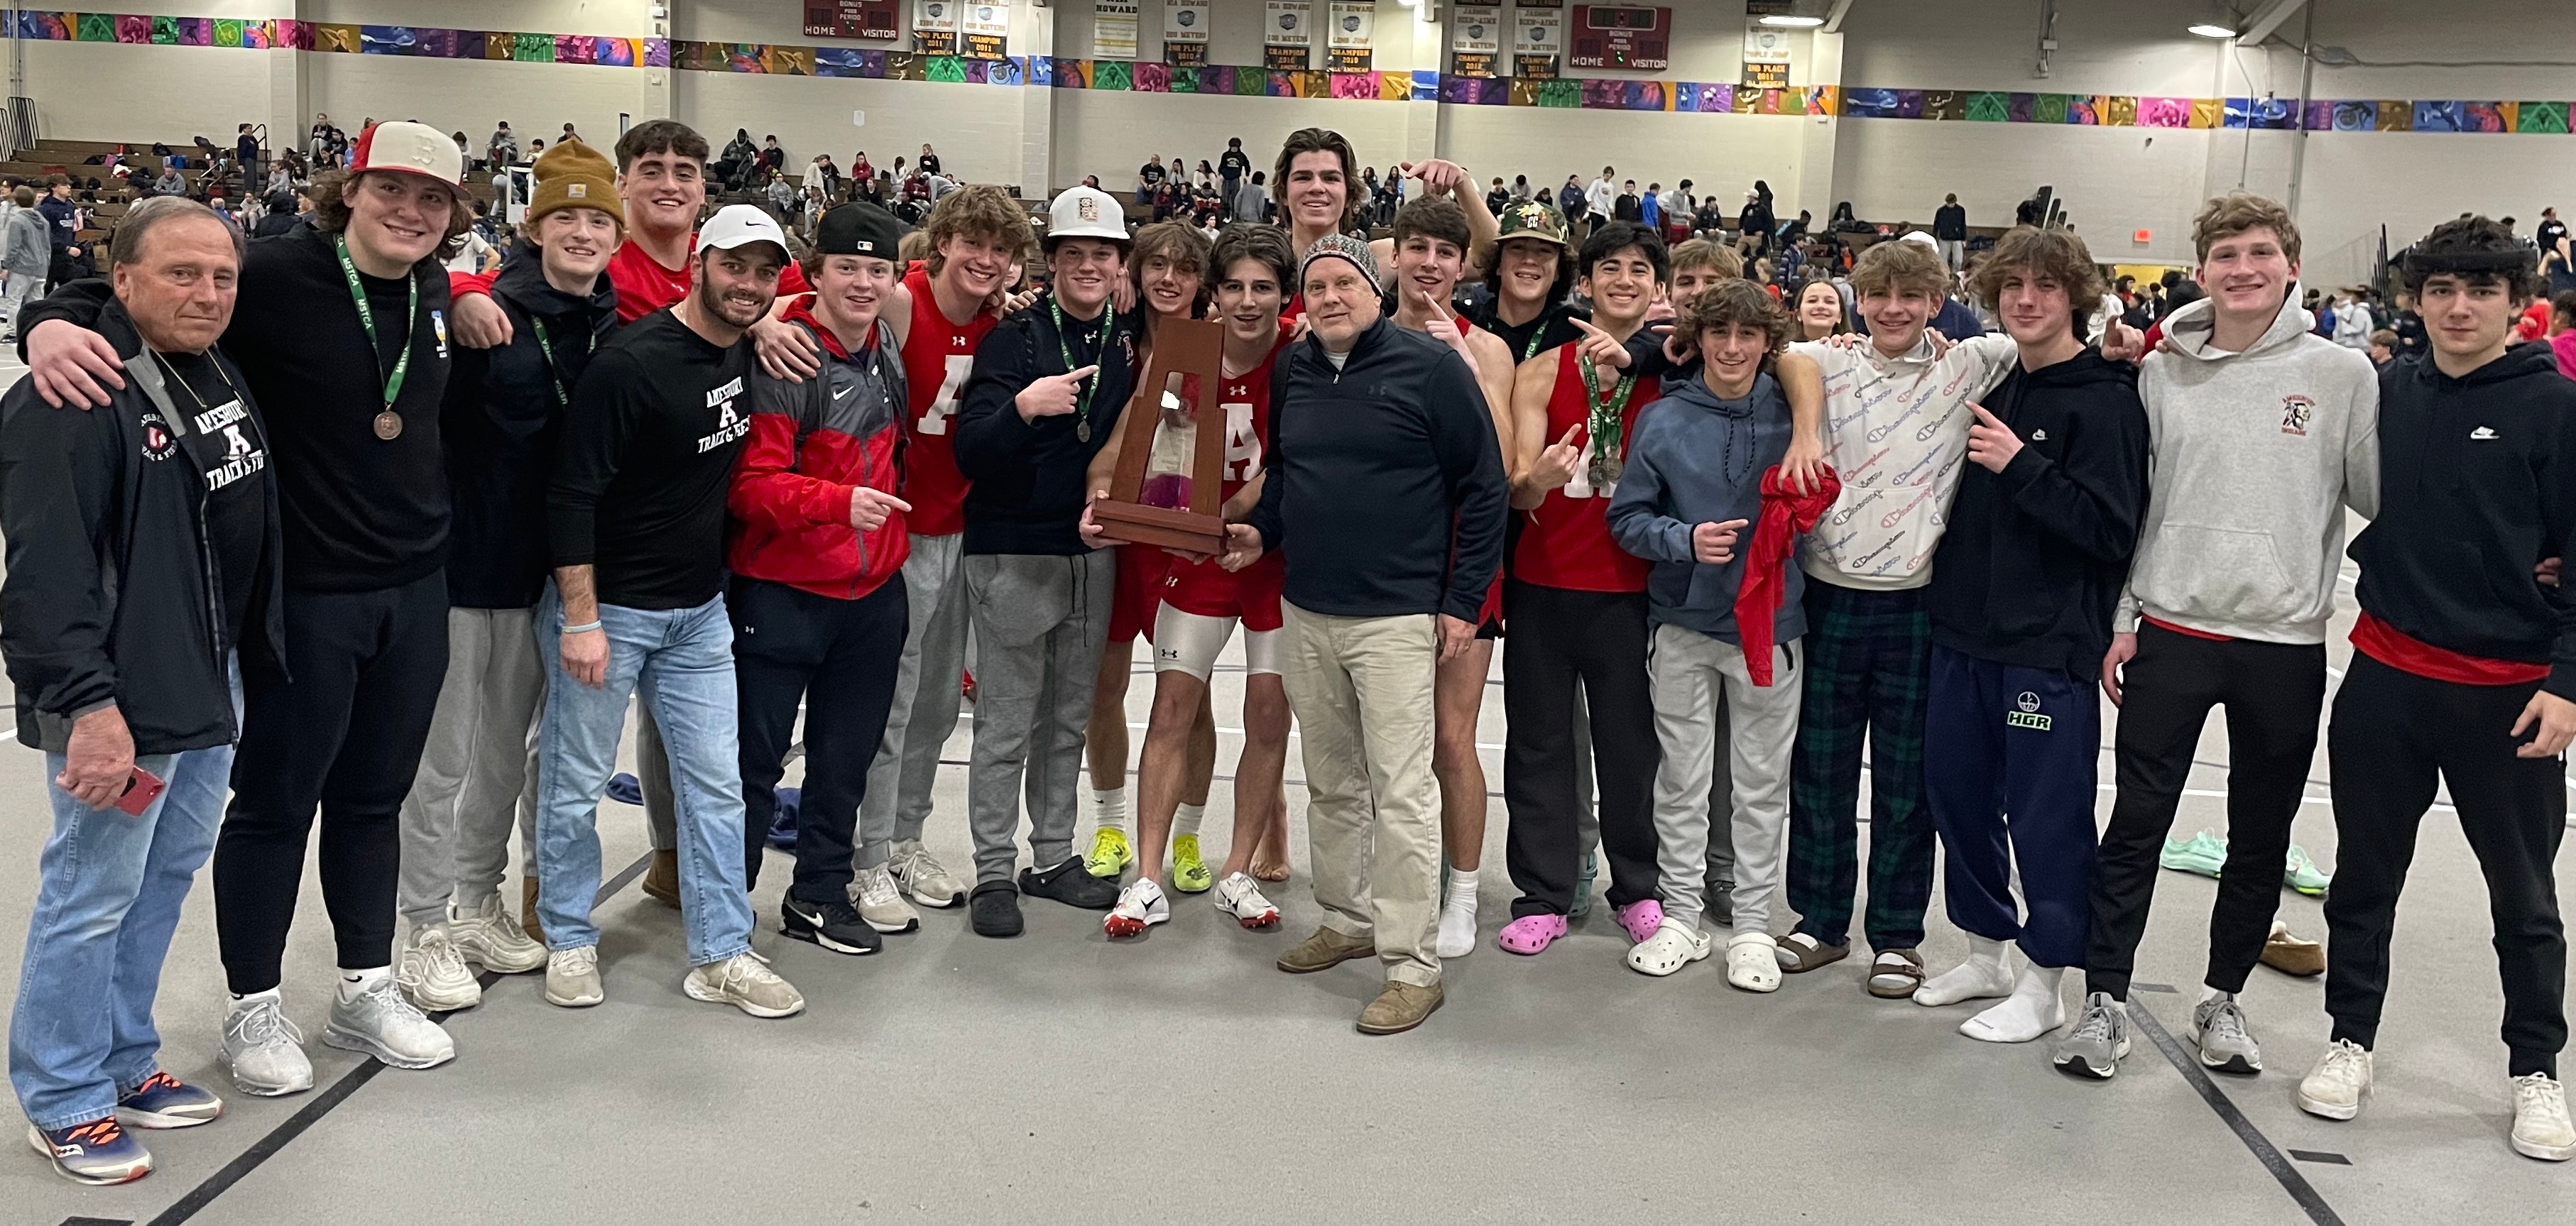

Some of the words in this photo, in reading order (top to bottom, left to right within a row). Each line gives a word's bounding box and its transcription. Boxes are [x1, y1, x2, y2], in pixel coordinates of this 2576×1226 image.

[1096, 5, 1138, 13] HOWARD
[805, 26, 836, 35] HOME
[862, 29, 896, 38] VISITOR
[968, 35, 1001, 45] CHAMPION
[976, 43, 992, 52] 2011
[1571, 58, 1604, 67] HOME
[1631, 59, 1667, 69] VISITOR
[342, 257, 360, 287] MSTCA
[357, 299, 373, 329] MSTCA
[1051, 304, 1061, 325] MSTCA
[719, 400, 738, 429] A
[1867, 385, 1938, 443] Champion
[222, 425, 251, 461] A
[1220, 403, 1262, 481] A
[206, 460, 244, 491] TRACK
[1843, 447, 1890, 483] Champion
[1892, 442, 1944, 486] Champion
[1852, 530, 1906, 569] Champion
[2007, 711, 2052, 730] HGR
